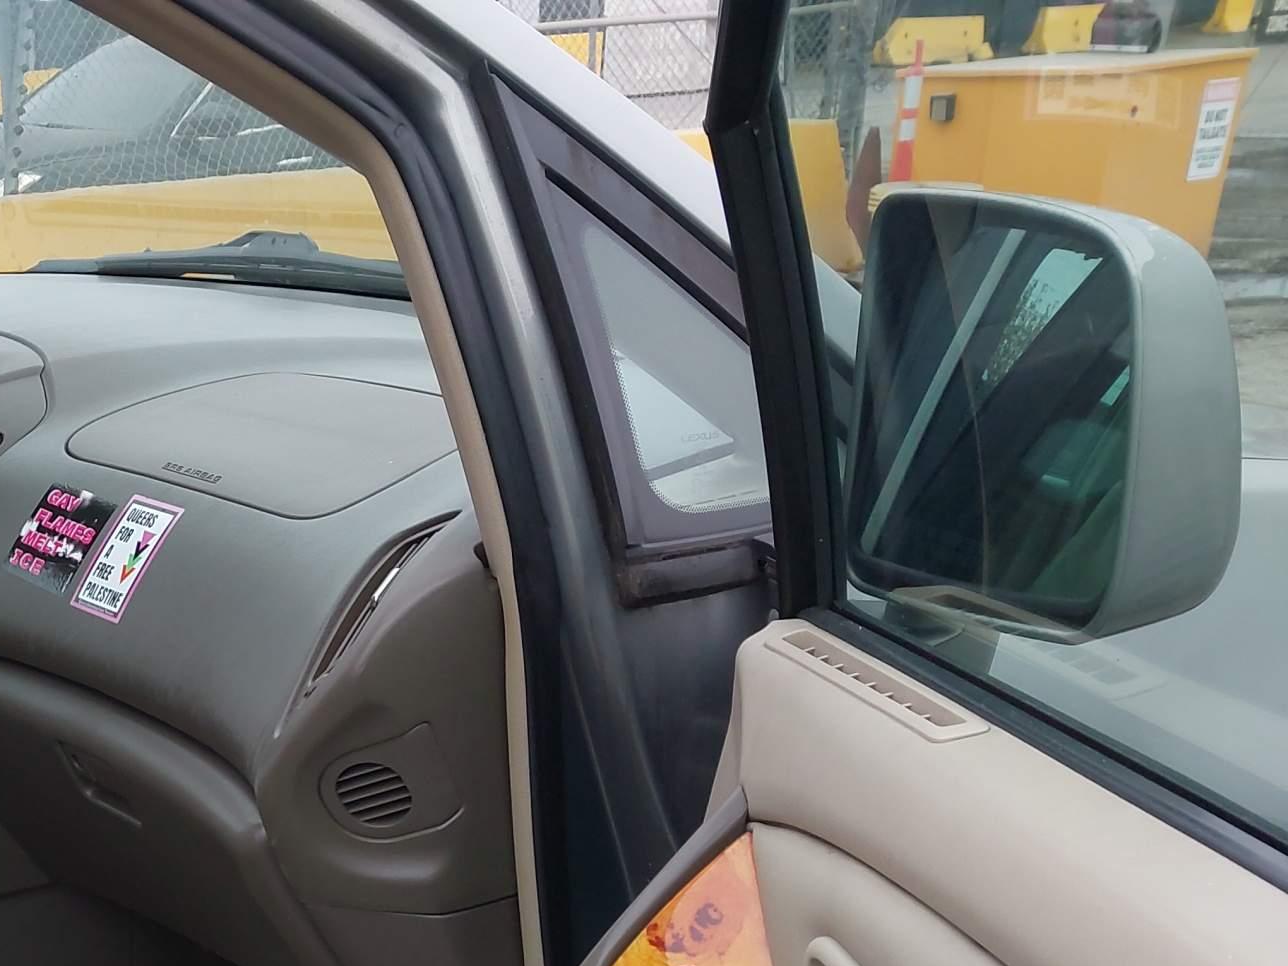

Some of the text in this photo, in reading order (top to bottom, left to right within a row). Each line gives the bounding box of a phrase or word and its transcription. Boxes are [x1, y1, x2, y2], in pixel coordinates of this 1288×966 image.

[184, 465, 223, 482] AIRBAG
[47, 489, 83, 512] GAY
[33, 507, 96, 544] FLAMES
[126, 508, 158, 528] QUEERS
[115, 526, 134, 543] FOR
[104, 544, 114, 559] A
[10, 548, 45, 576] ICE
[92, 562, 115, 581] FREE
[82, 581, 124, 608] PALESTINE
